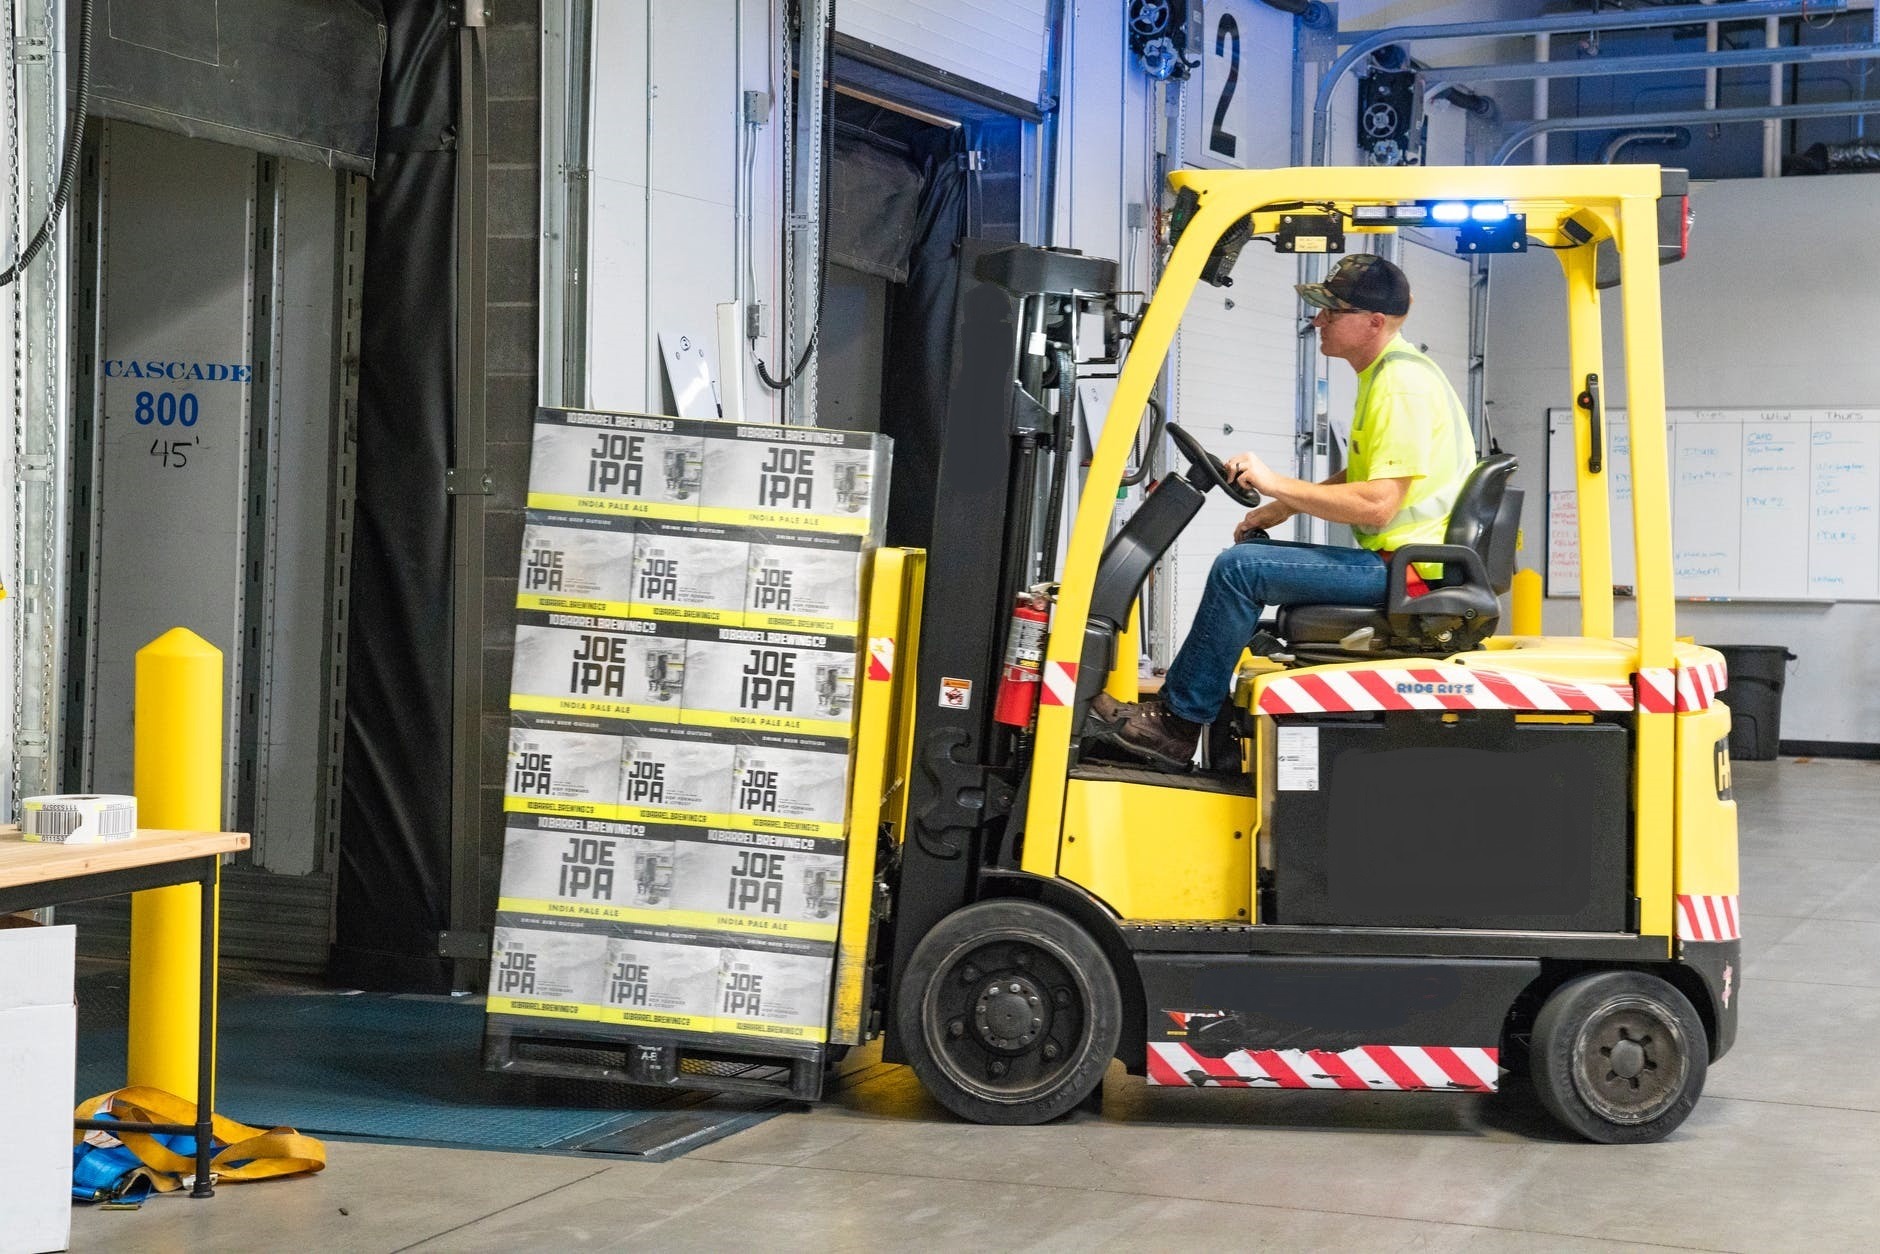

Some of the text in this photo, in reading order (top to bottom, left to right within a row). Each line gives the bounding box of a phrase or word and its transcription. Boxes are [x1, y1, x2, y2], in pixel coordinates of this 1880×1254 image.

[1210, 13, 1240, 158] 2
[105, 360, 252, 383] CASCADE
[135, 391, 198, 426] 800
[151, 436, 199, 467] 45'
[592, 434, 644, 462] JOE
[762, 447, 815, 475] JOE
[588, 460, 643, 495] IPA
[759, 474, 813, 509] IPA
[578, 500, 648, 512] INDIA PALE ALE
[780, 516, 800, 524] PALE
[528, 549, 564, 568] JOE
[642, 559, 678, 578] JOE
[526, 567, 562, 591] IPA
[640, 577, 677, 601] IPA
[756, 568, 792, 588] JOE
[754, 587, 790, 611] IPA
[573, 635, 627, 663] JOE
[744, 649, 797, 678] JOE
[570, 662, 625, 697] IPA
[1397, 683, 1433, 694] RIDE
[740, 676, 795, 712] IPA
[560, 701, 630, 714] INDIA PALE ALE
[730, 716, 756, 724] INDIA
[760, 718, 781, 727] PALE
[516, 752, 552, 772] JOE
[629, 761, 665, 780] JOE
[514, 771, 551, 795] IPA
[627, 779, 663, 803] IPA
[742, 770, 778, 789] JOE
[740, 788, 776, 812] IPA
[562, 838, 616, 866] JOE
[731, 851, 785, 880] JOE
[559, 865, 614, 900] IPA
[728, 878, 783, 914] IPA
[549, 904, 619, 917] INDIA PALE ALE
[717, 917, 788, 931] INDIA PALE ALE
[500, 952, 536, 971] JOE
[613, 963, 649, 983] JOE
[498, 970, 535, 994] IPA
[610, 981, 648, 1006] IPA
[726, 973, 763, 992] JOE
[724, 991, 760, 1016] IPA
